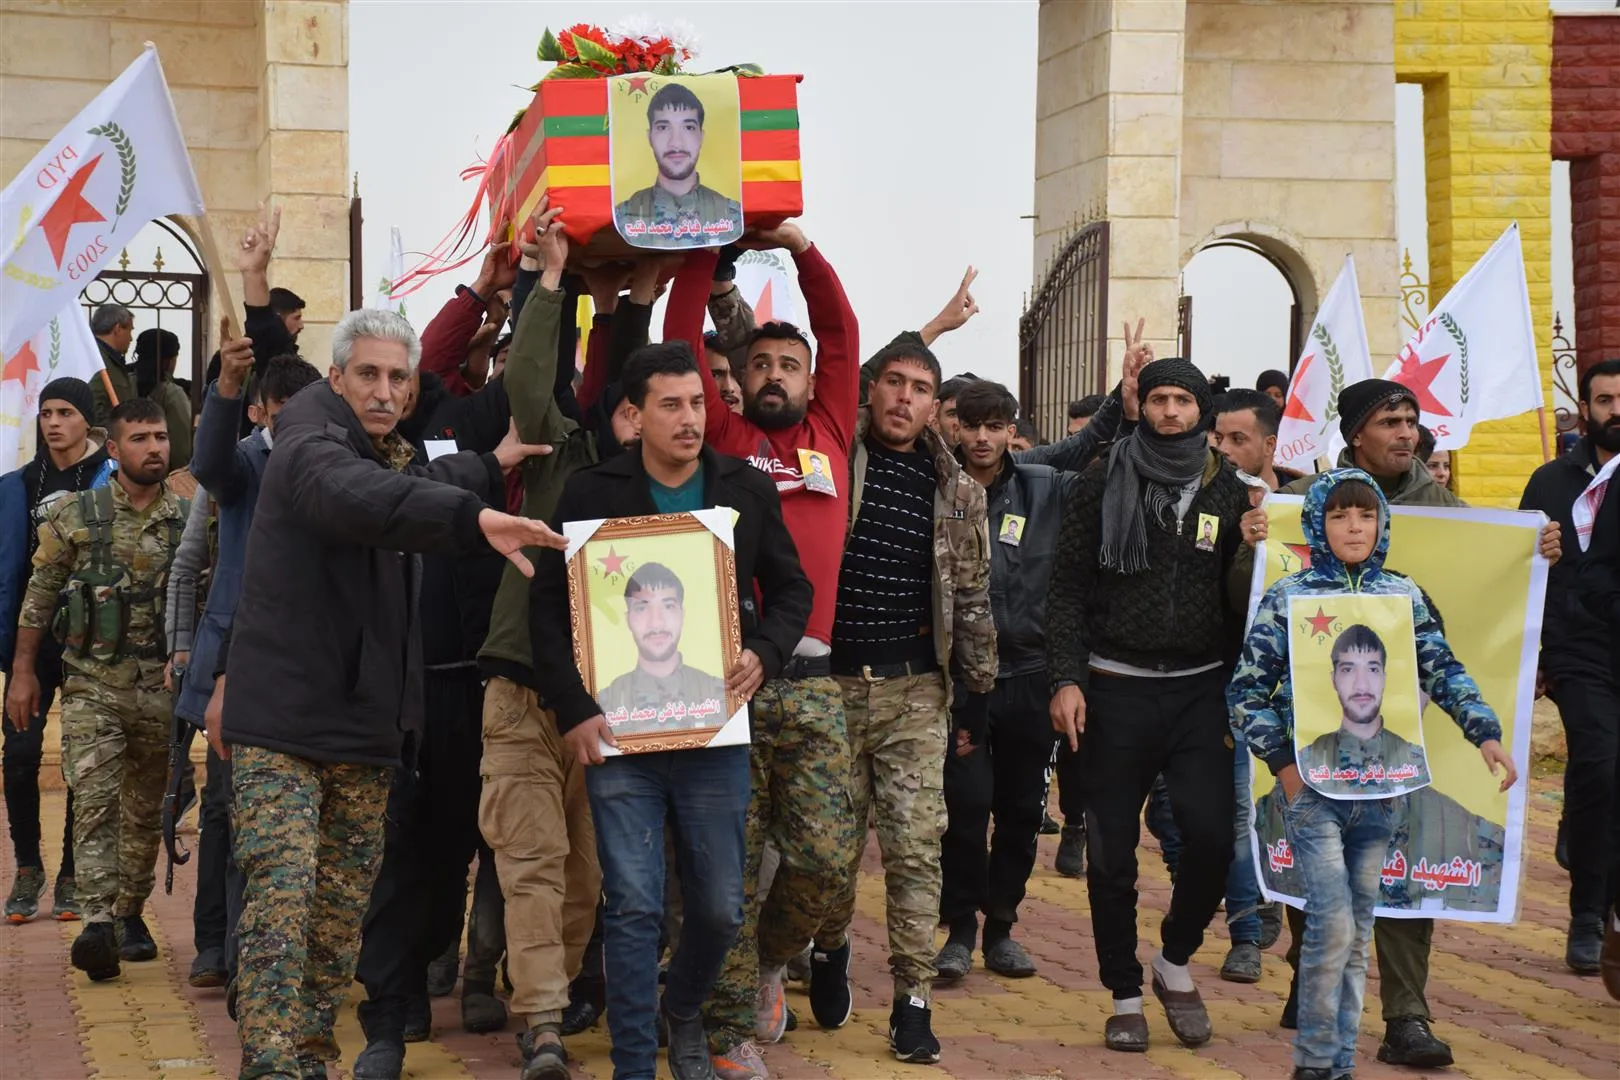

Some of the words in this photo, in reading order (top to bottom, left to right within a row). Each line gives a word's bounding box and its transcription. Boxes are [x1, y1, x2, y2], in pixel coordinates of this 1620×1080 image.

[648, 222, 673, 235] محمد
[703, 219, 733, 236] الشهيد
[746, 455, 784, 473] NIKE
[1280, 554, 1291, 572] Y
[630, 706, 656, 721] محمد
[688, 698, 720, 718] الشهيد
[1332, 767, 1359, 780] محمد
[1387, 763, 1419, 783] الشهيد
[1411, 856, 1481, 891] الشهيد
